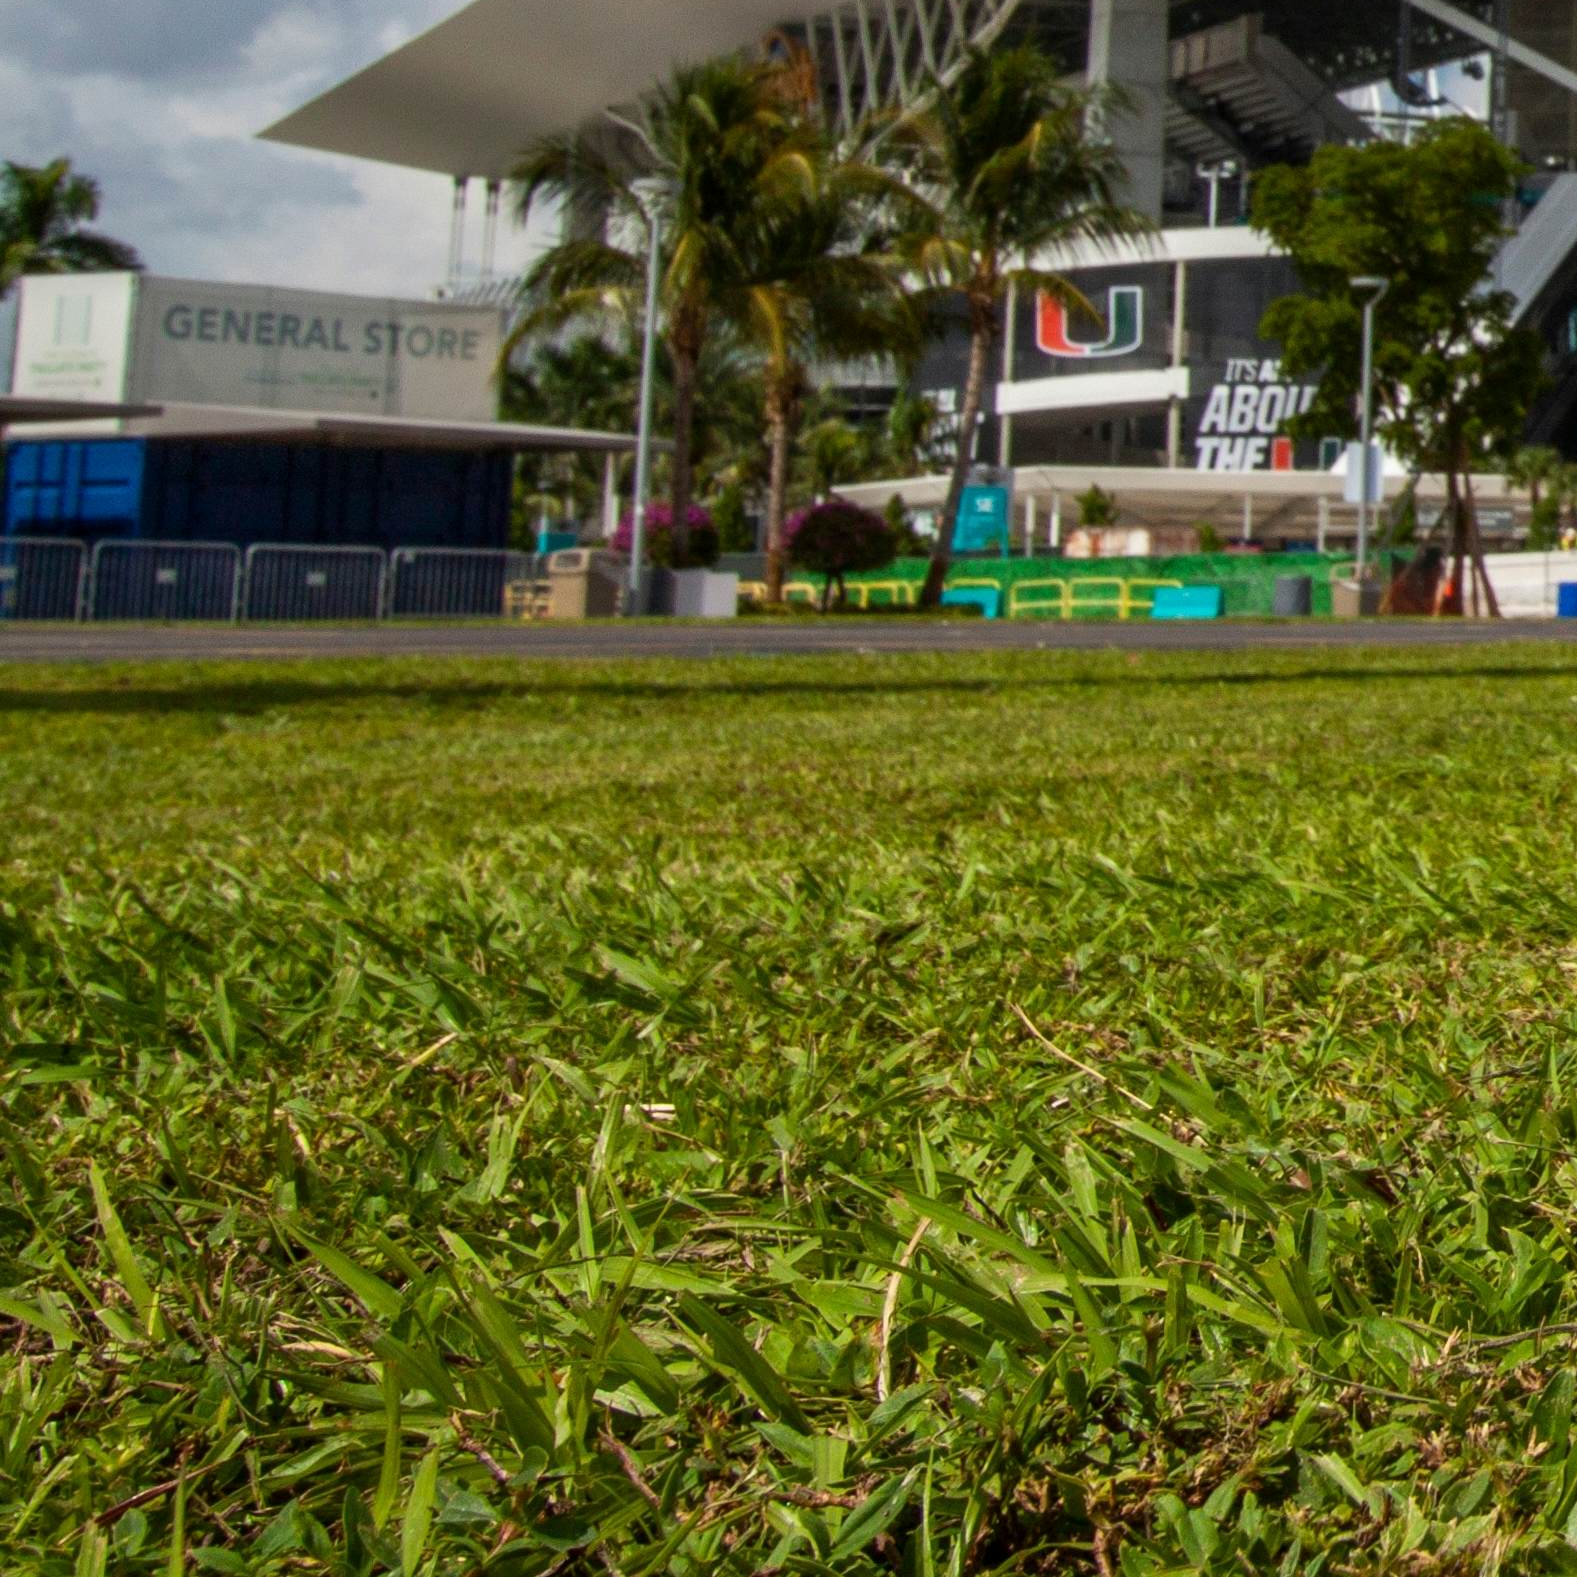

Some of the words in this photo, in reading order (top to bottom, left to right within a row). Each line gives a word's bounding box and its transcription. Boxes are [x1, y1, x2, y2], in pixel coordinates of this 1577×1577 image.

[163, 304, 350, 353] GENERAL
[363, 320, 481, 360] STORE
[1195, 436, 1268, 472] THE
